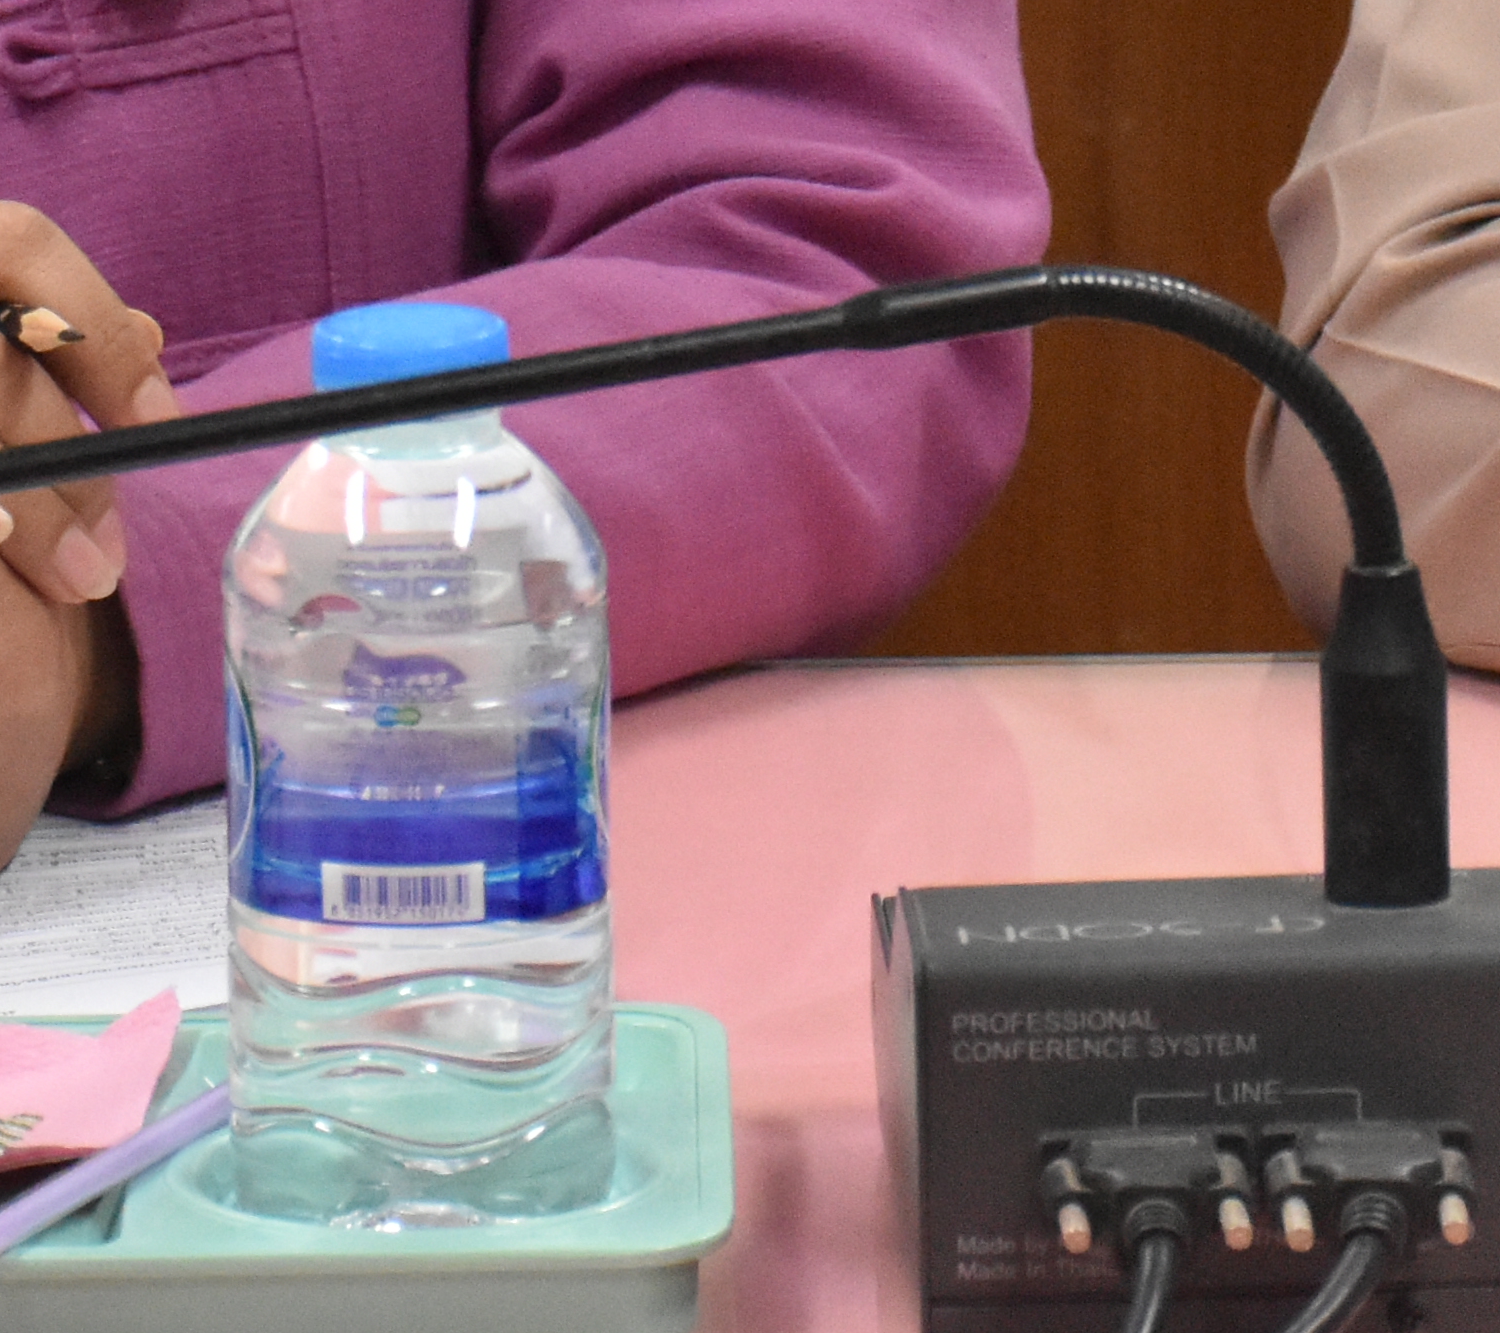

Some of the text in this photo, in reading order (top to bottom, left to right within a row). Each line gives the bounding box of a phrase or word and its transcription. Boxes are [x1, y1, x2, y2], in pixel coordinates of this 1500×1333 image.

[952, 1009, 1157, 1033] PROFESSIONAL
[952, 1033, 1257, 1062] CONFERENCE SYSTEM
[1214, 1081, 1283, 1106] LINE
